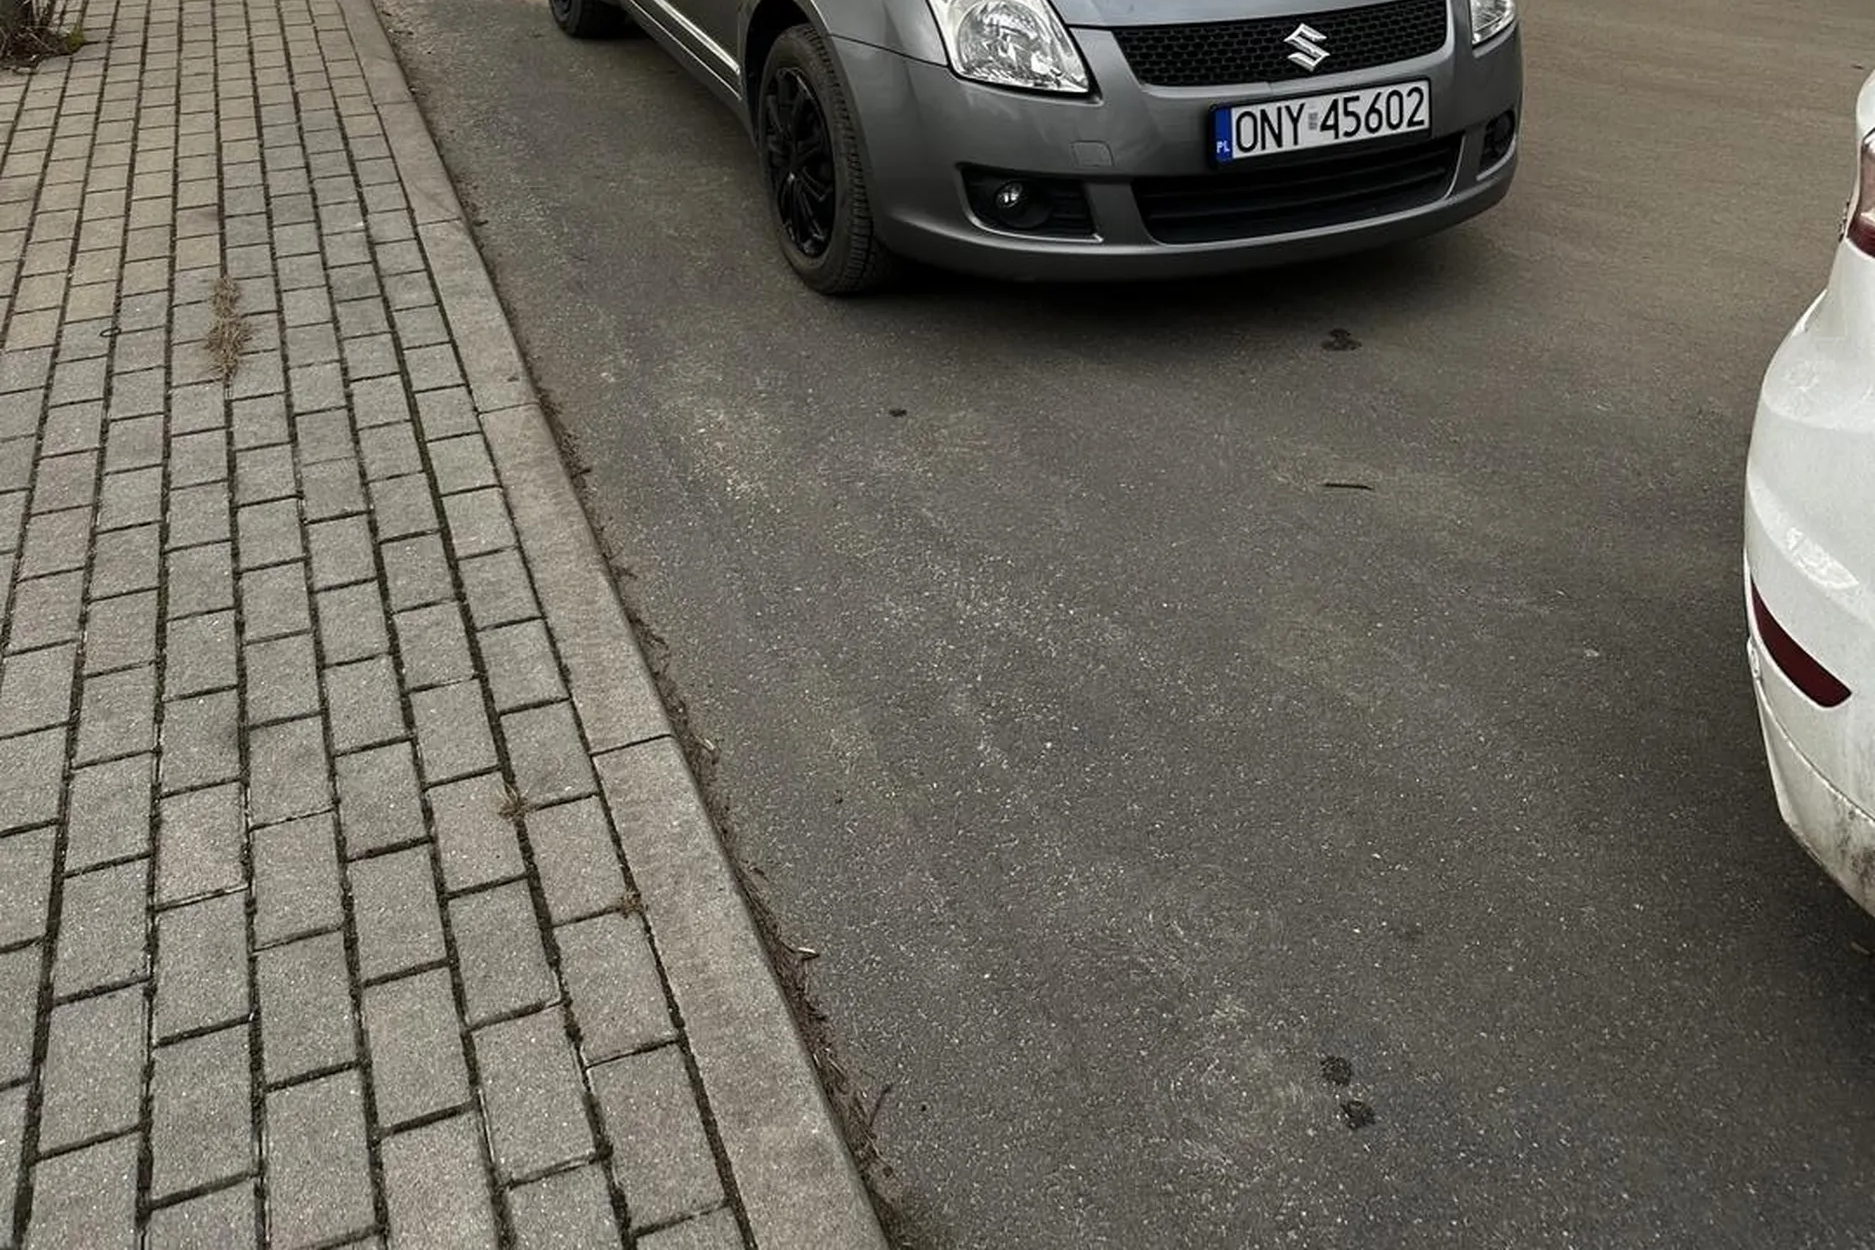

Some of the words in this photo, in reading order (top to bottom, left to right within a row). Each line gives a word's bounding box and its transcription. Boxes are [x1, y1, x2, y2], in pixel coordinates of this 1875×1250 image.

[1235, 102, 1306, 153] ONY
[1319, 86, 1425, 140] 45602
[1216, 140, 1231, 154] PL
